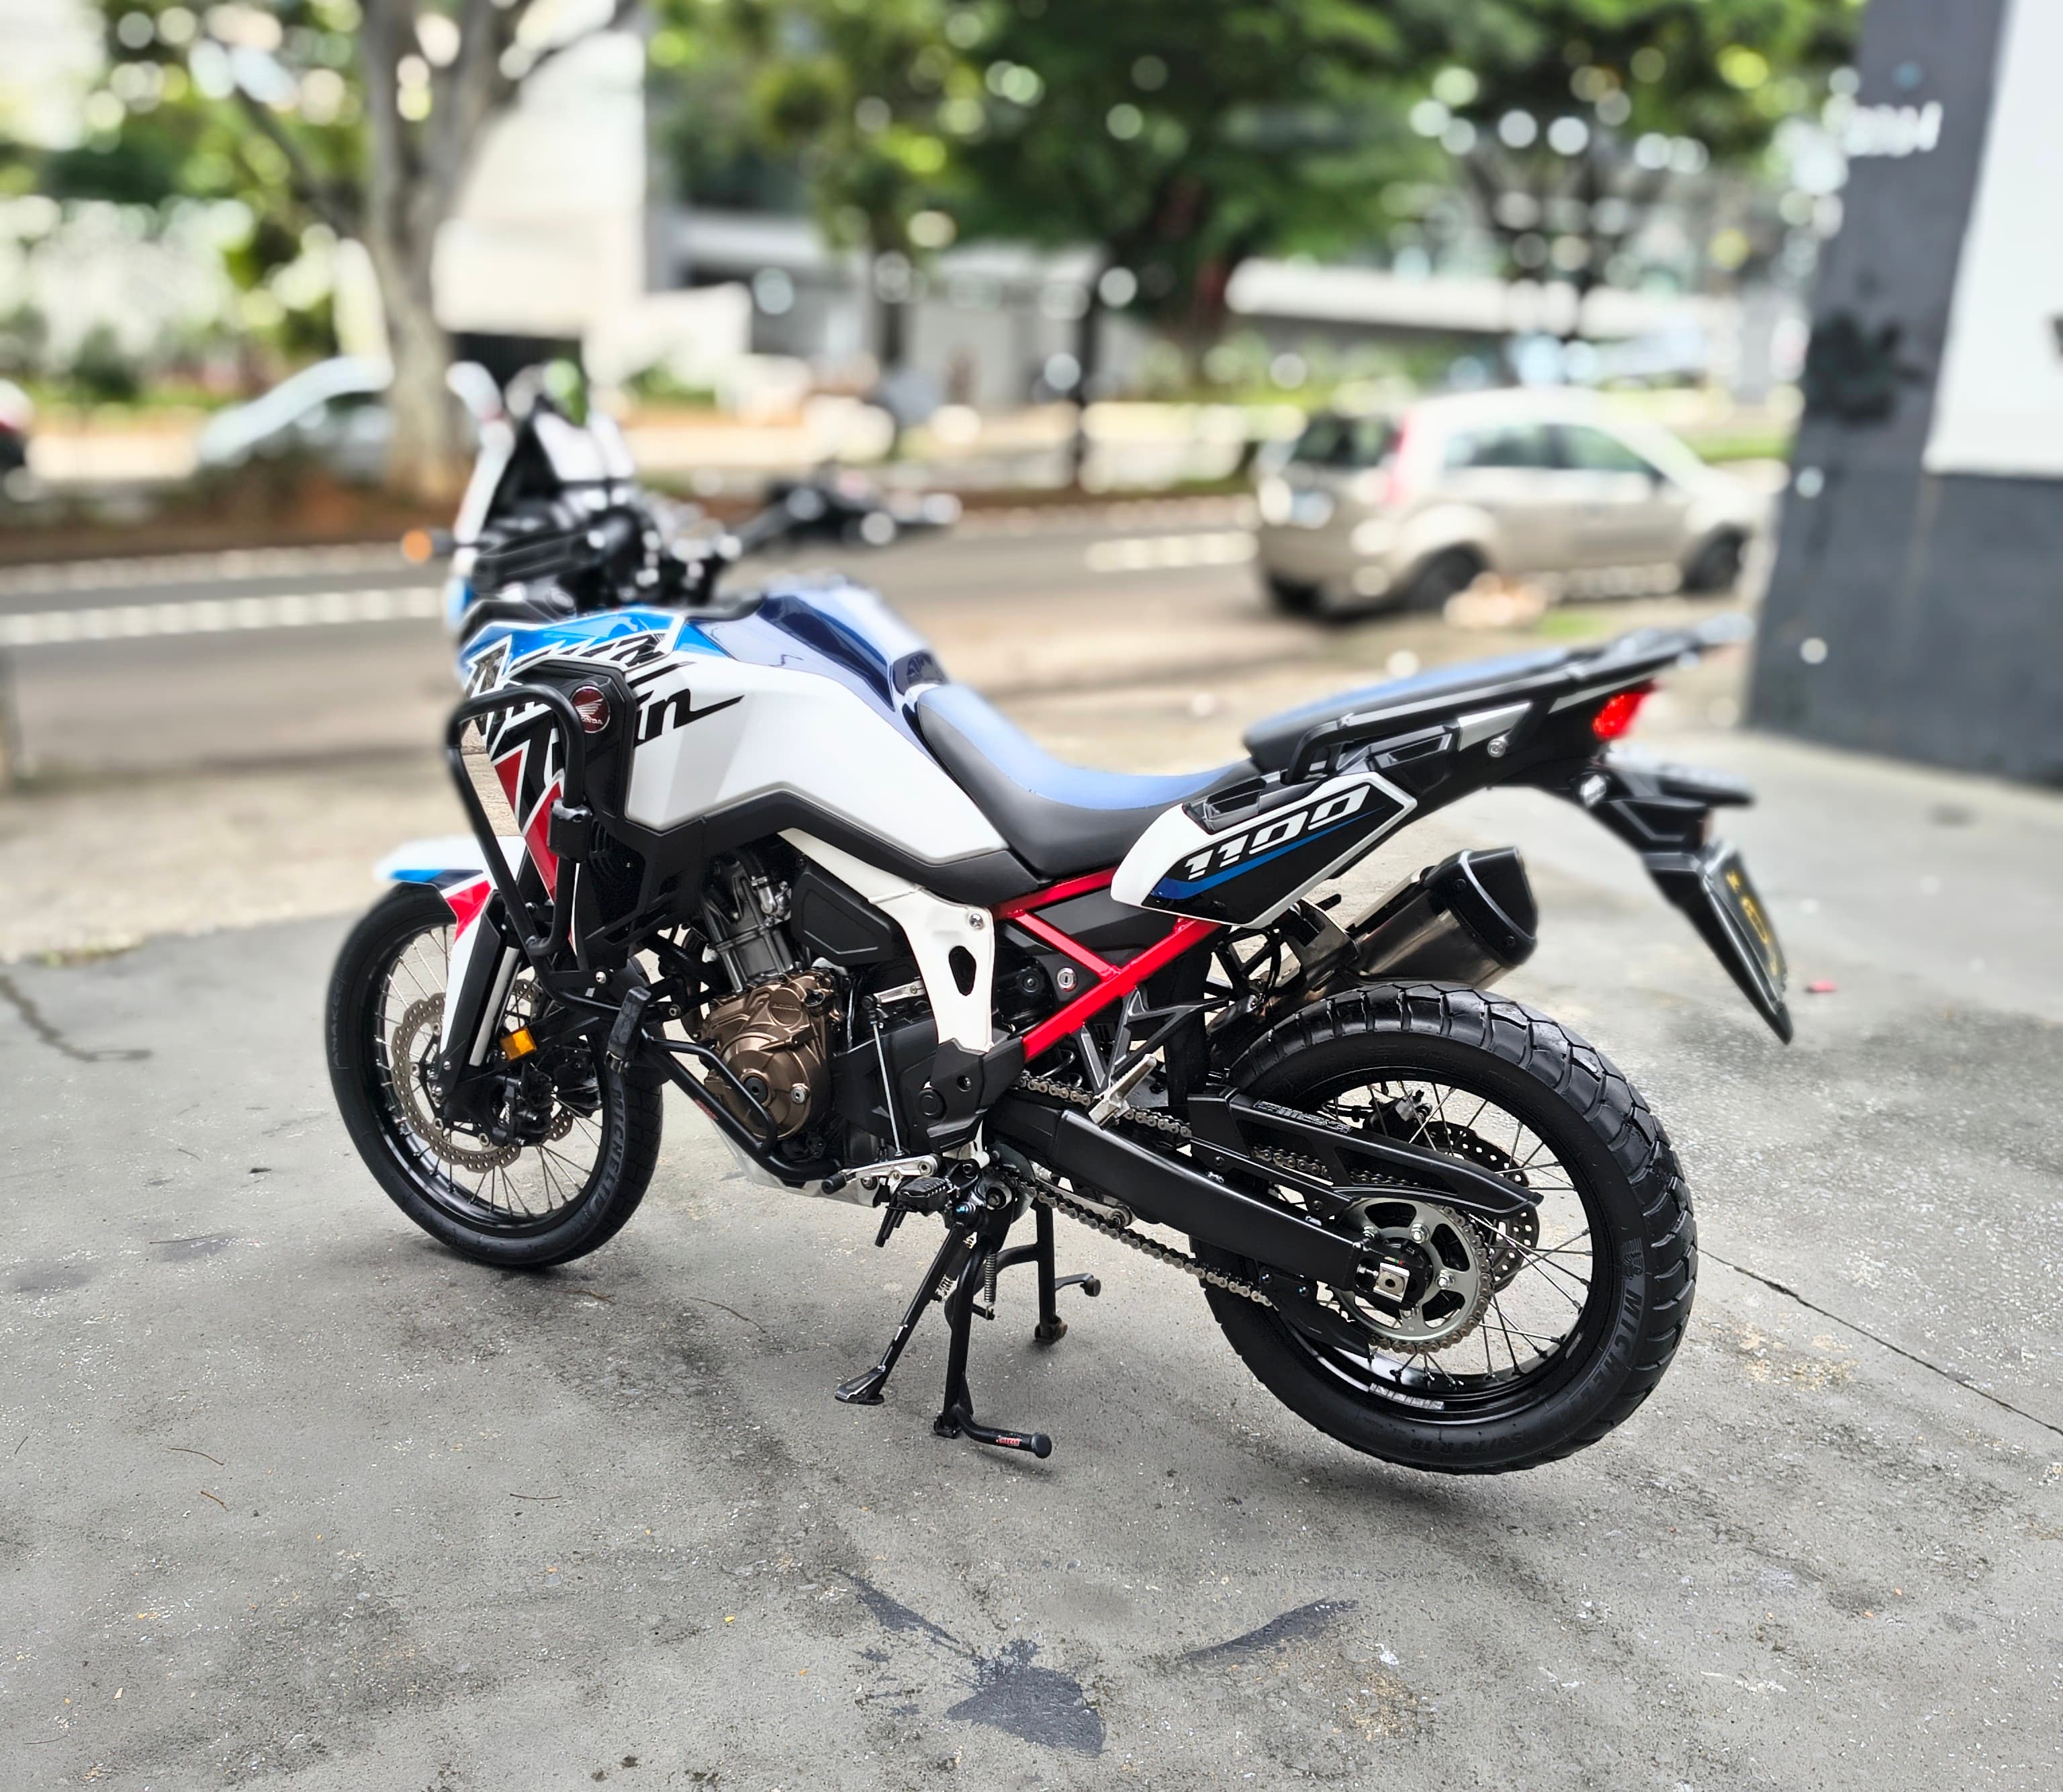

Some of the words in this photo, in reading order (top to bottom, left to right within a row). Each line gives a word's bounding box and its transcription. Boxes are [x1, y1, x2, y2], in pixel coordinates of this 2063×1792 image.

[580, 716, 603, 725] ONDA
[1185, 785, 1371, 881] 1100
[593, 1087, 625, 1212] MICHELIN
